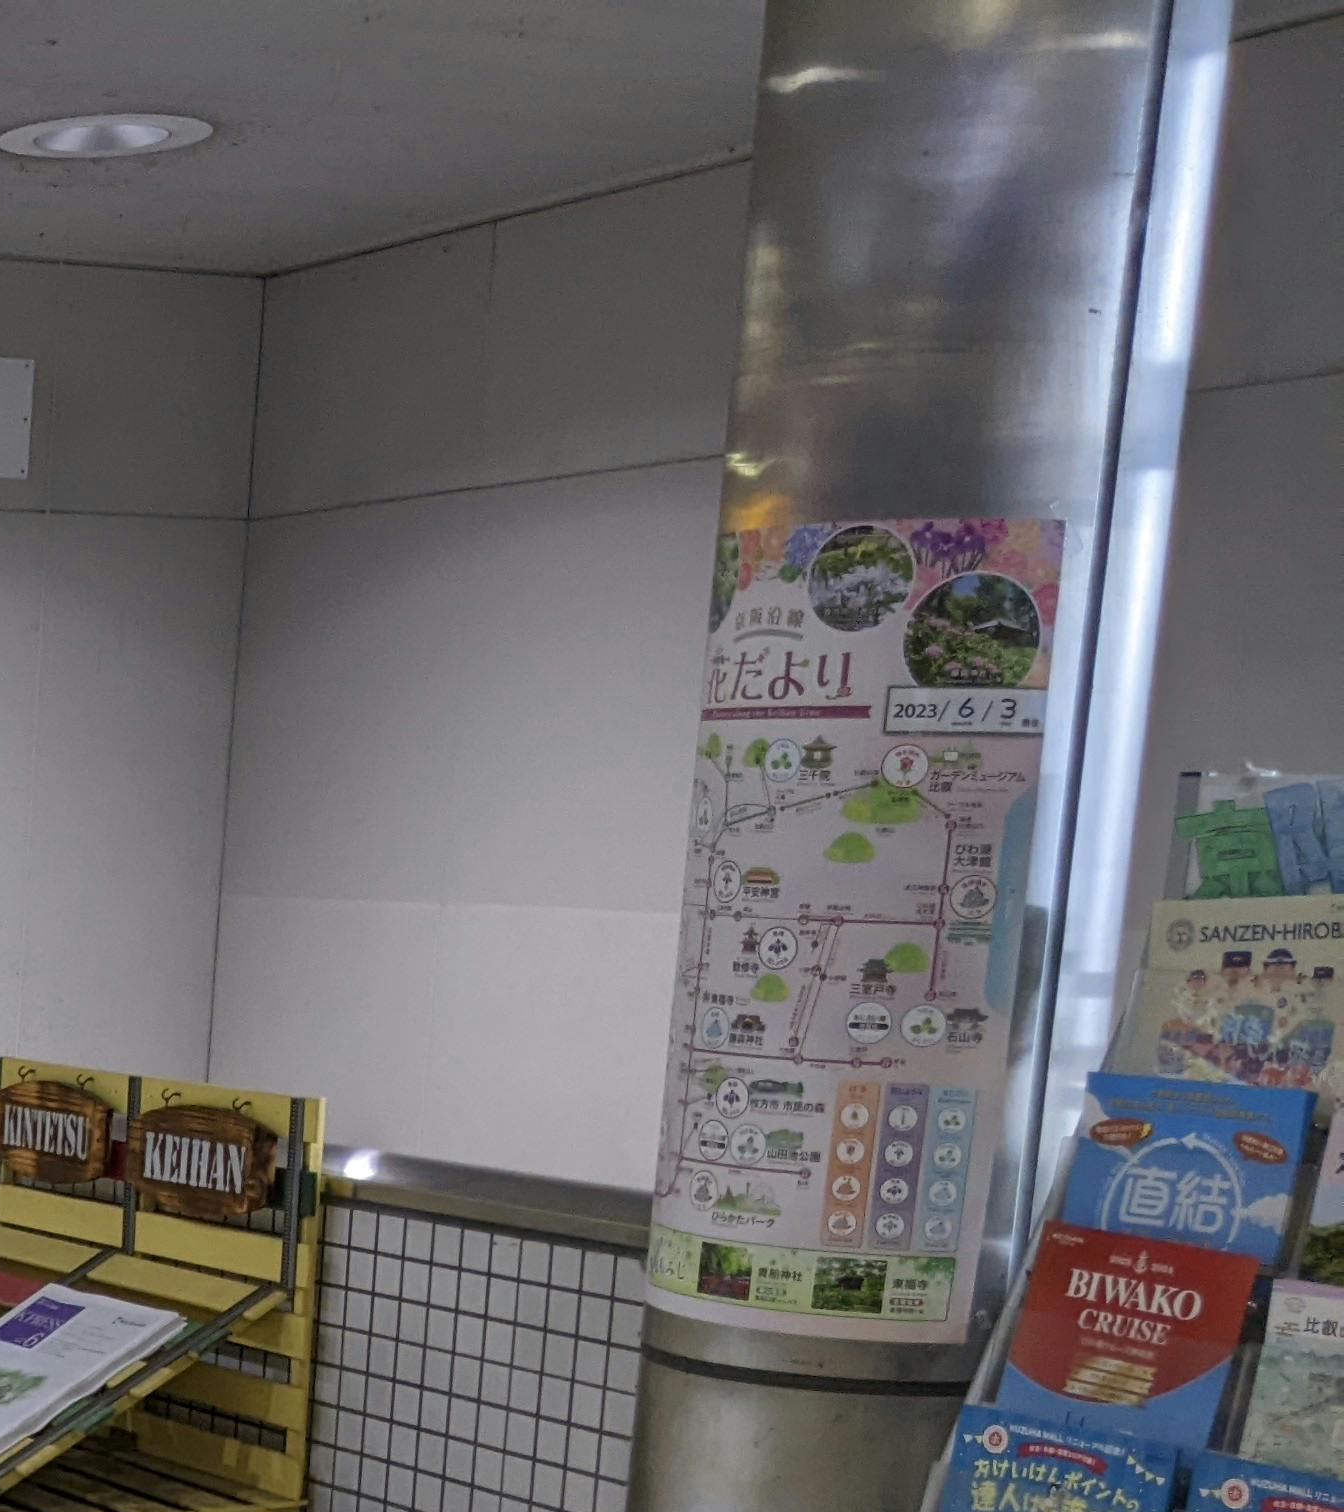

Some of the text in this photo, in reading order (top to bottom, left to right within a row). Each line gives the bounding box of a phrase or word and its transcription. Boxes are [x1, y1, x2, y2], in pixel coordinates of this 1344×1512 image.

[735, 607, 805, 630] 京阪沿線
[708, 647, 852, 704] 花だより
[799, 770, 832, 781] 三千院
[930, 770, 1026, 782] ガーデンミュージアム
[955, 844, 992, 855] びわ湖
[1199, 922, 1344, 942] SANZEN-HIROB
[947, 1032, 982, 1043] 石山寺
[783, 1101, 825, 1113] 市民の森
[2, 1104, 90, 1161] KINTETSU
[144, 1131, 246, 1195] KEIHAN
[1119, 1166, 1232, 1234] 直結
[712, 1212, 775, 1228] ひらかたパーク
[758, 1269, 802, 1282] 貴船神社
[1065, 1268, 1203, 1321] BIWAKO
[1077, 1309, 1171, 1345] CRUISE
